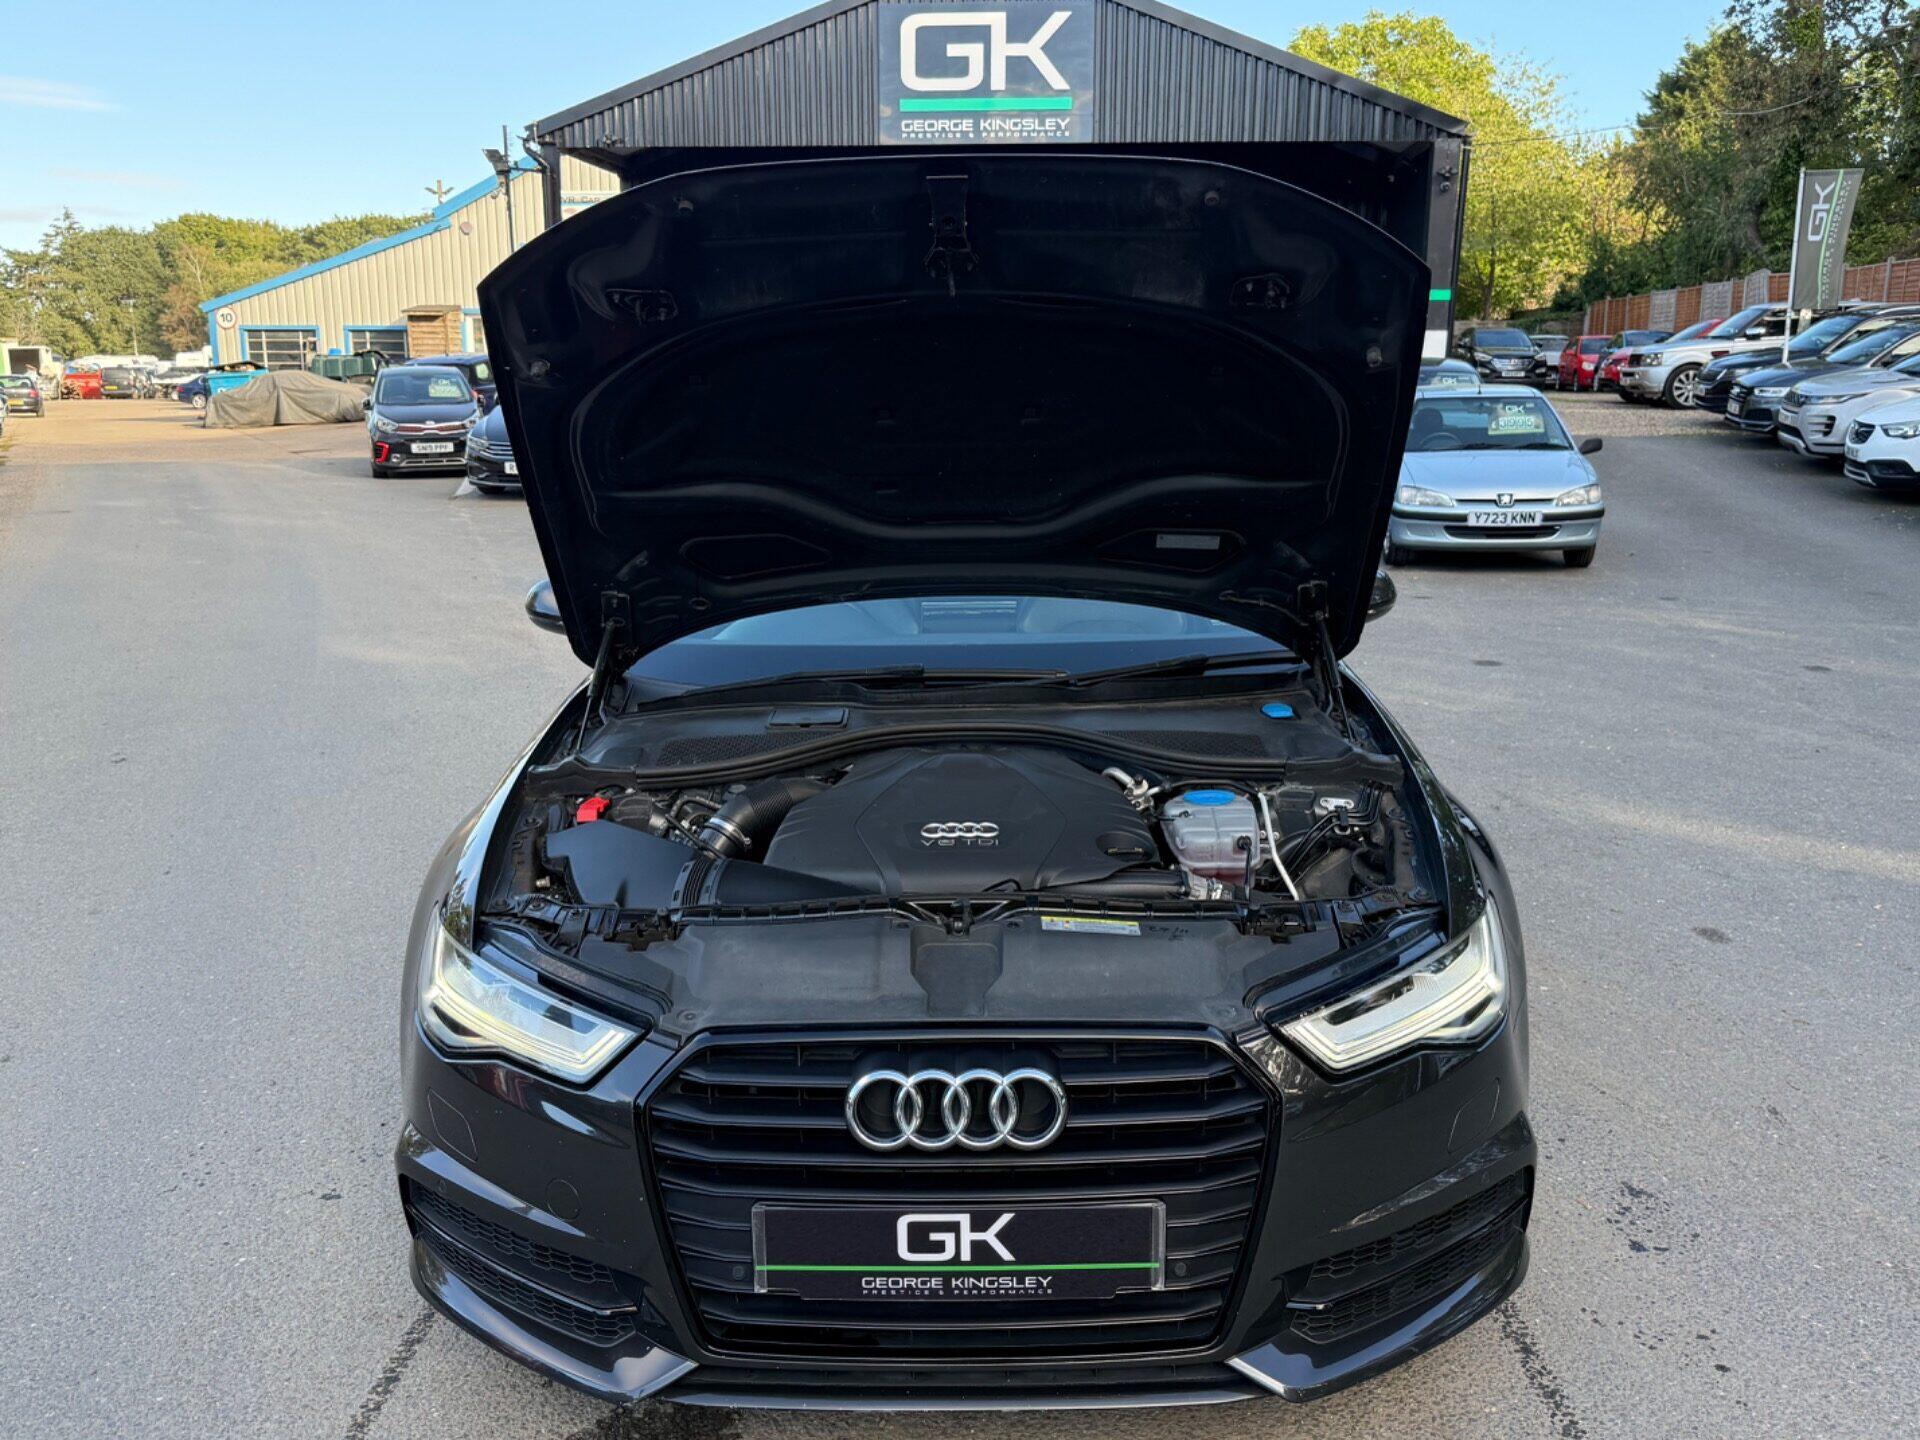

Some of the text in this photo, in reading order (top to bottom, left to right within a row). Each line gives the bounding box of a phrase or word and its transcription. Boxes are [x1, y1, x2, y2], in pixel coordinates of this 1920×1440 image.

[900, 11, 1073, 91] GK
[901, 117, 1070, 132] GEORGE KINGSLEY
[1807, 182, 1836, 241] GK
[220, 313, 233, 322] 10
[1474, 512, 1536, 524] Y723 KNN
[961, 838, 999, 846] TDI
[896, 1213, 1016, 1261] GK
[861, 1276, 1053, 1289] GEORGE KINGSLEY
